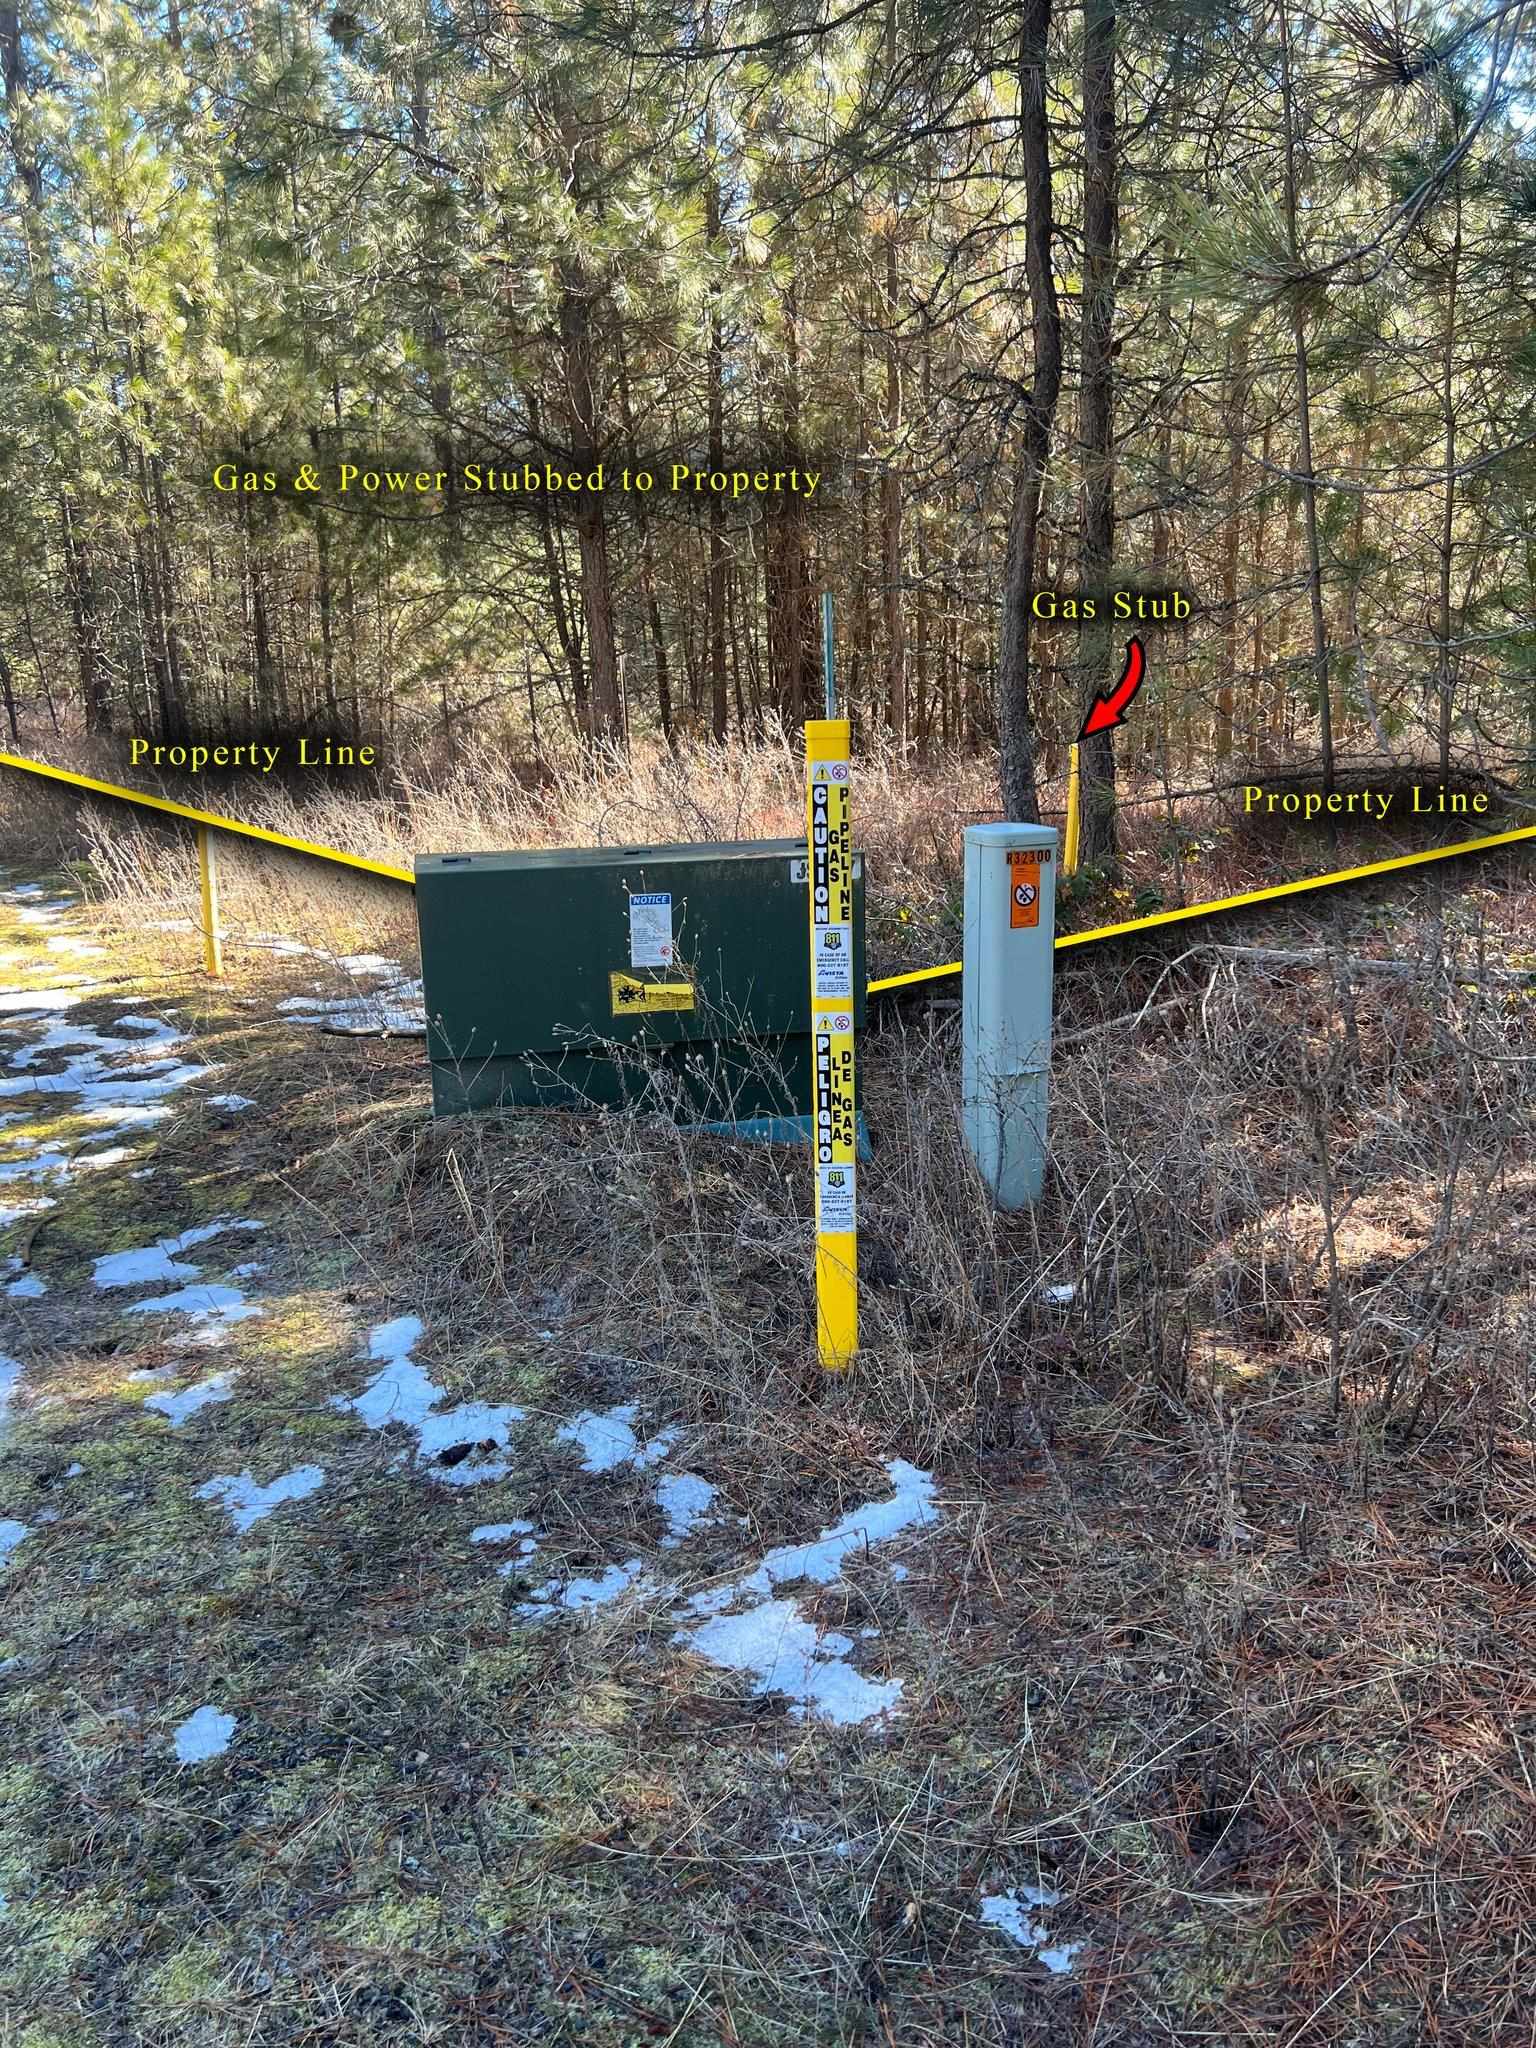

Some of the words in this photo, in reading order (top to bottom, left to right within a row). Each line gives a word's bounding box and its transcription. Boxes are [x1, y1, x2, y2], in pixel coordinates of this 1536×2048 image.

[813, 785, 829, 923] CAUTION
[829, 830, 840, 883] GAS
[839, 787, 851, 921] PIPELINE
[1006, 848, 1051, 865] R32300
[632, 895, 668, 905] NOTICE
[825, 932, 840, 944] 811
[841, 1050, 851, 1082] DE
[817, 1036, 832, 1162] PELIGRO
[842, 1097, 853, 1146] GAS
[829, 1172, 843, 1182] 811
